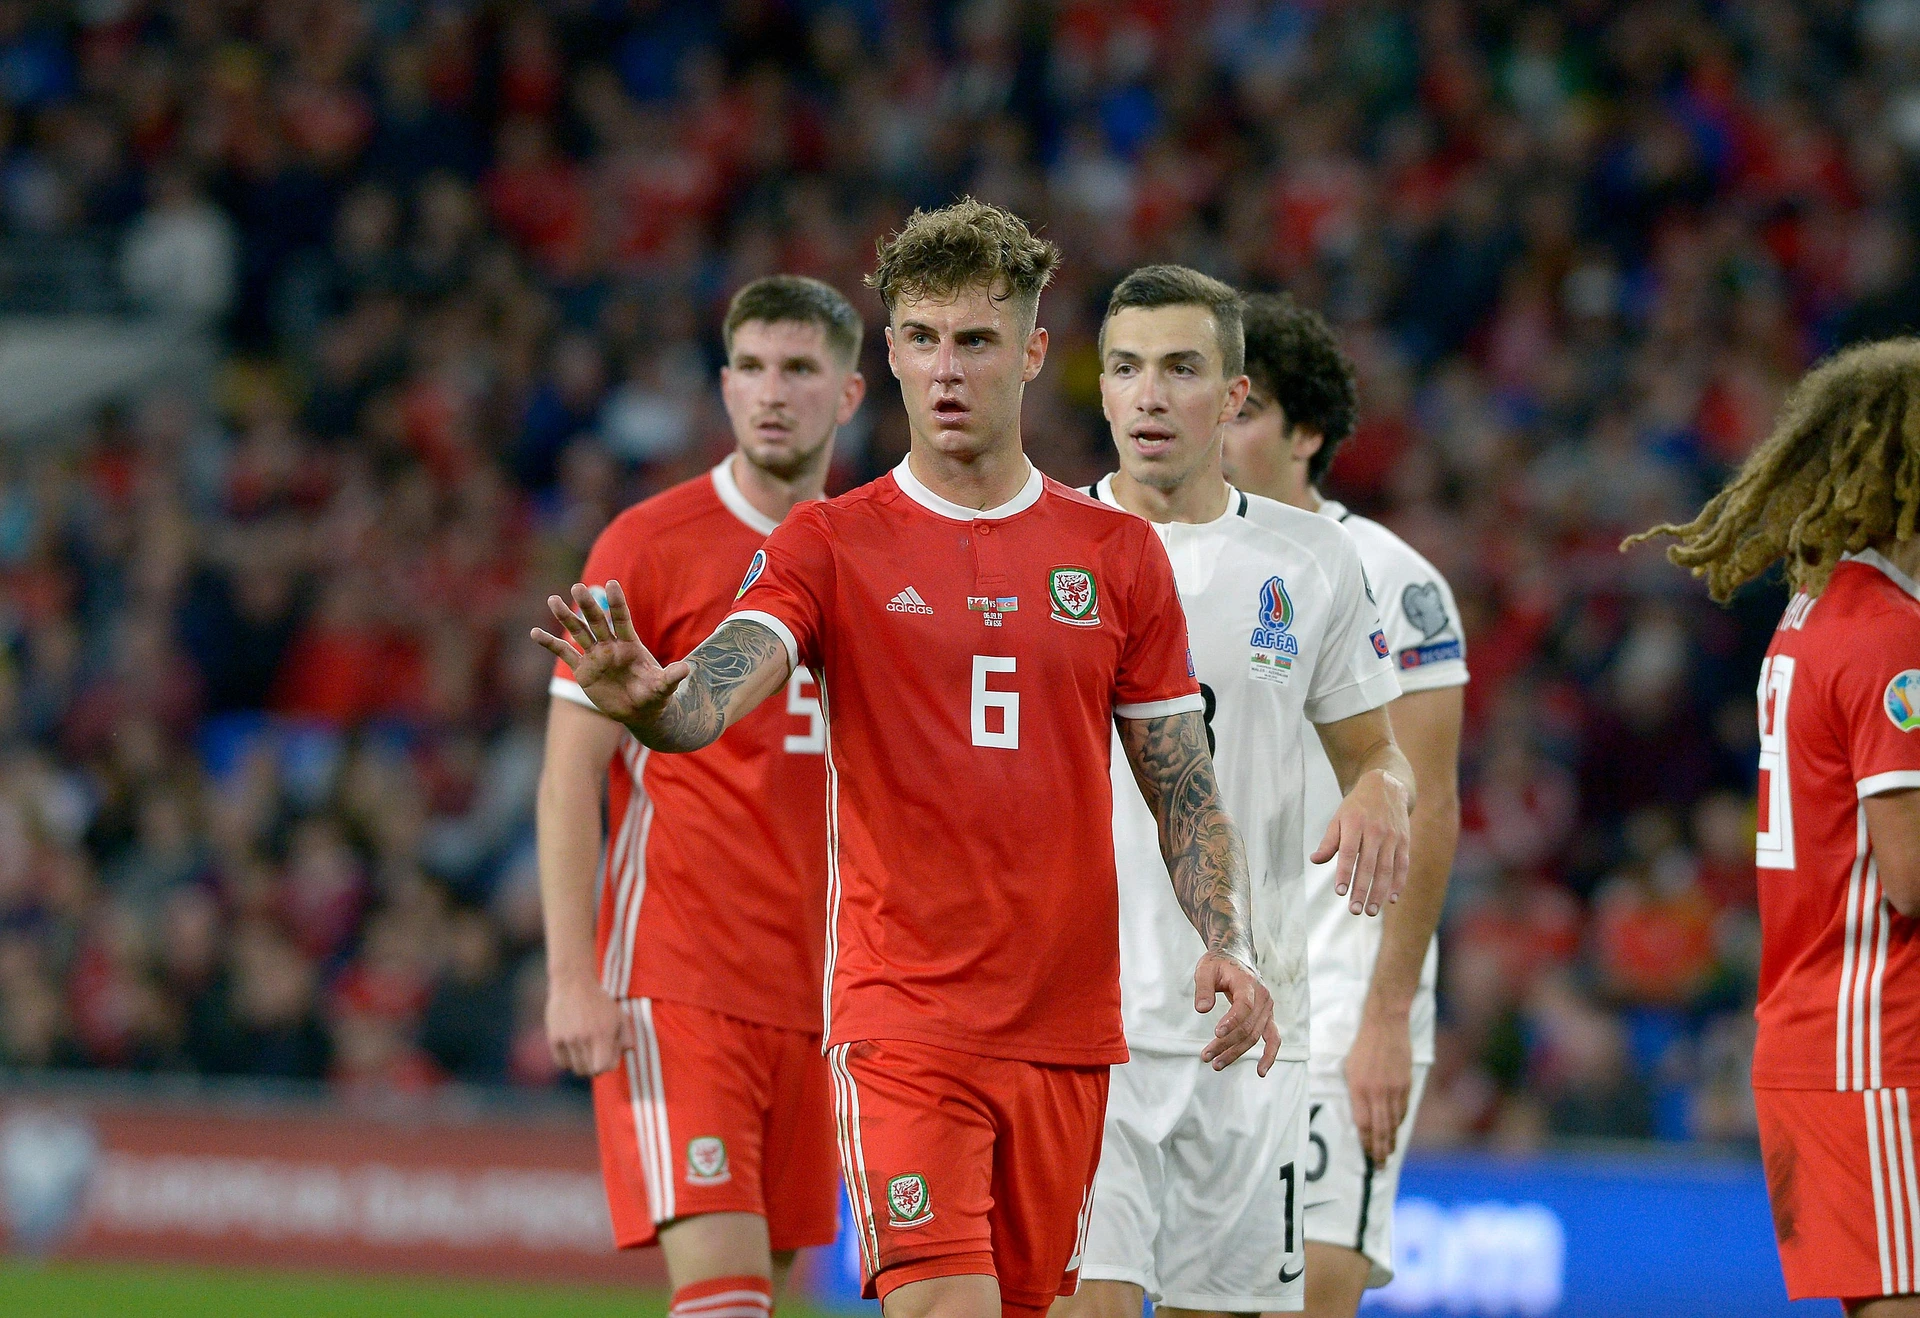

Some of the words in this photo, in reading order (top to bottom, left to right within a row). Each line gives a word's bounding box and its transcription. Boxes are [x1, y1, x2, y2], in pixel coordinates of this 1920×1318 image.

[886, 603, 934, 616] adidas
[1250, 628, 1298, 655] AFFA
[784, 665, 825, 754] 5
[971, 655, 1020, 750] 6
